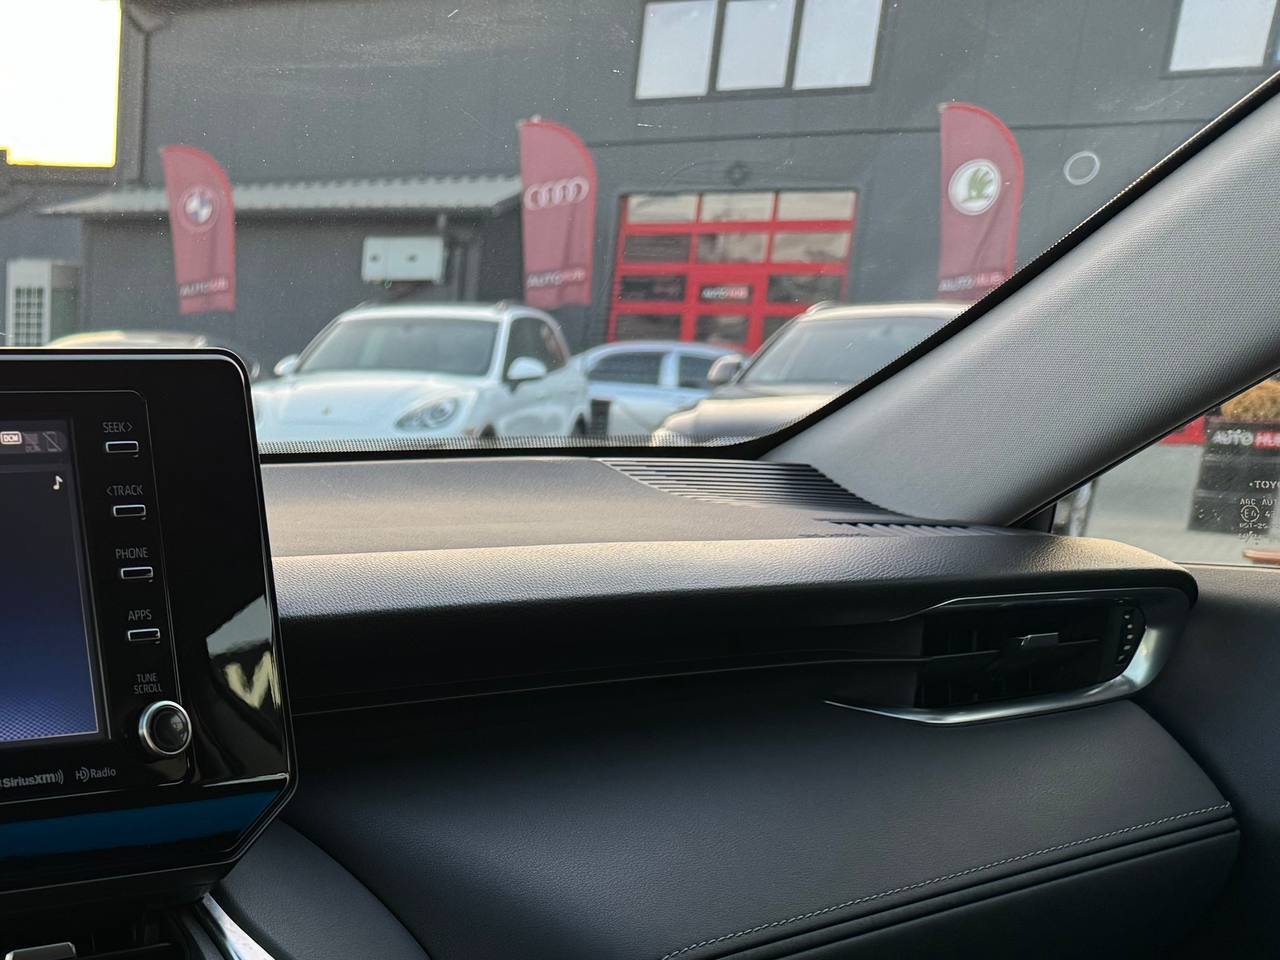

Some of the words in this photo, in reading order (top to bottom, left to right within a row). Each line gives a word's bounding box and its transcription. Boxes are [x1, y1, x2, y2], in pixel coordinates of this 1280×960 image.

[1211, 430, 1254, 446] AUTO
[115, 547, 149, 560] PHONE
[128, 608, 153, 622] APPS
[137, 673, 158, 683] TUNE
[91, 767, 117, 778] Radio
